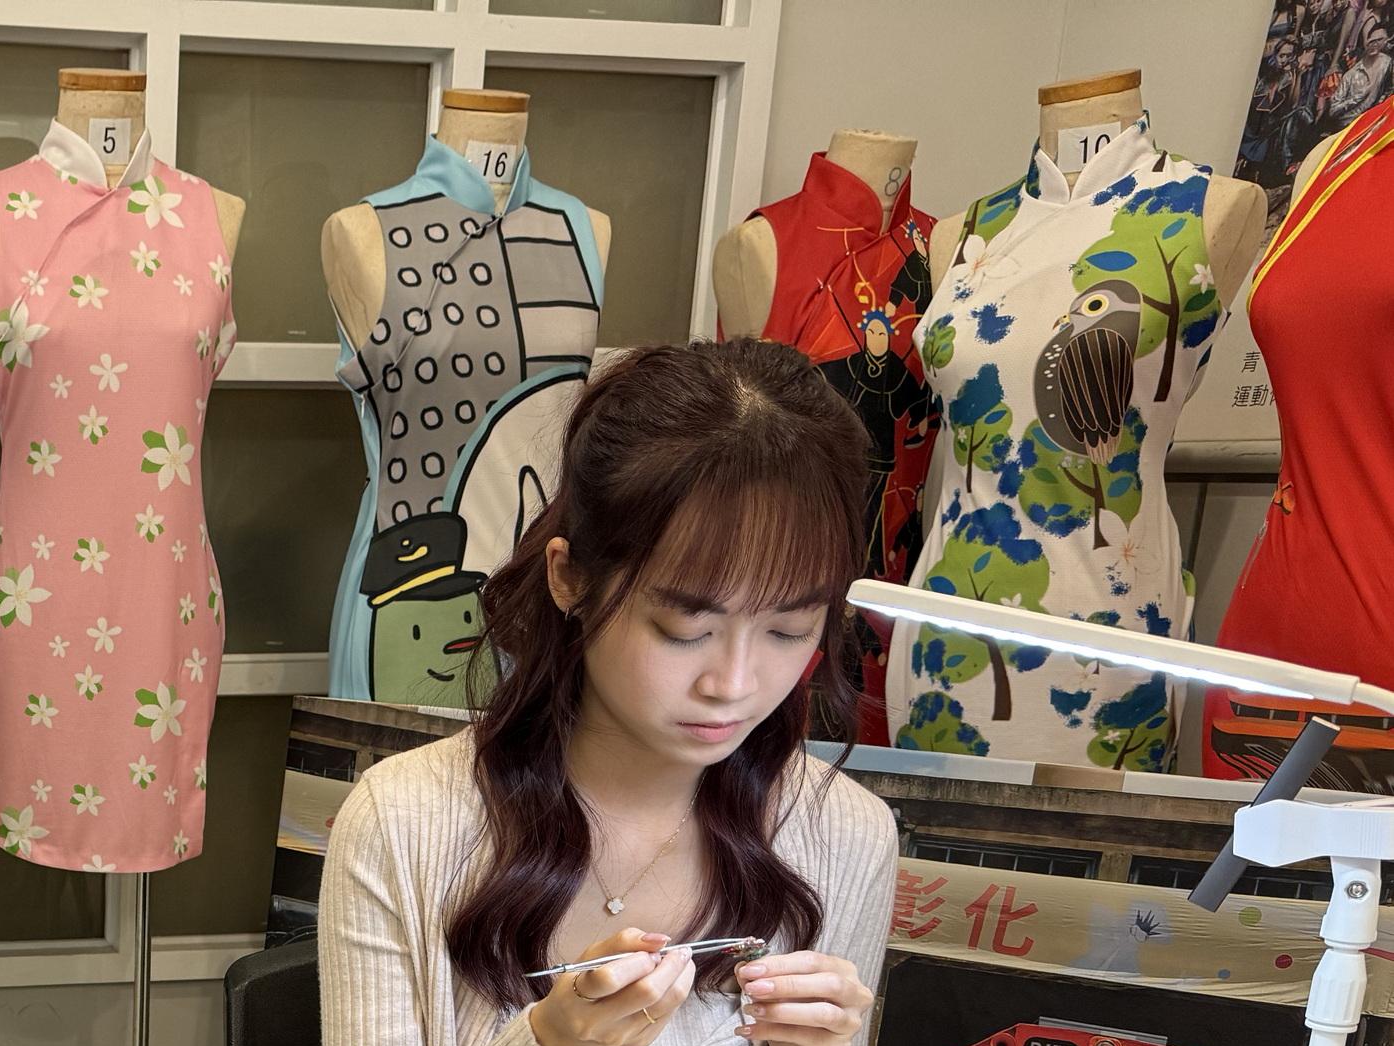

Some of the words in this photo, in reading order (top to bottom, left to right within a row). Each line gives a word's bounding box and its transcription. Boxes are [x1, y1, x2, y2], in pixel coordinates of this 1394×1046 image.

[103, 126, 116, 154] 5
[483, 149, 508, 178] 16
[884, 166, 902, 197] 8
[1241, 351, 1261, 373] 青
[889, 868, 1039, 957] 彰化
